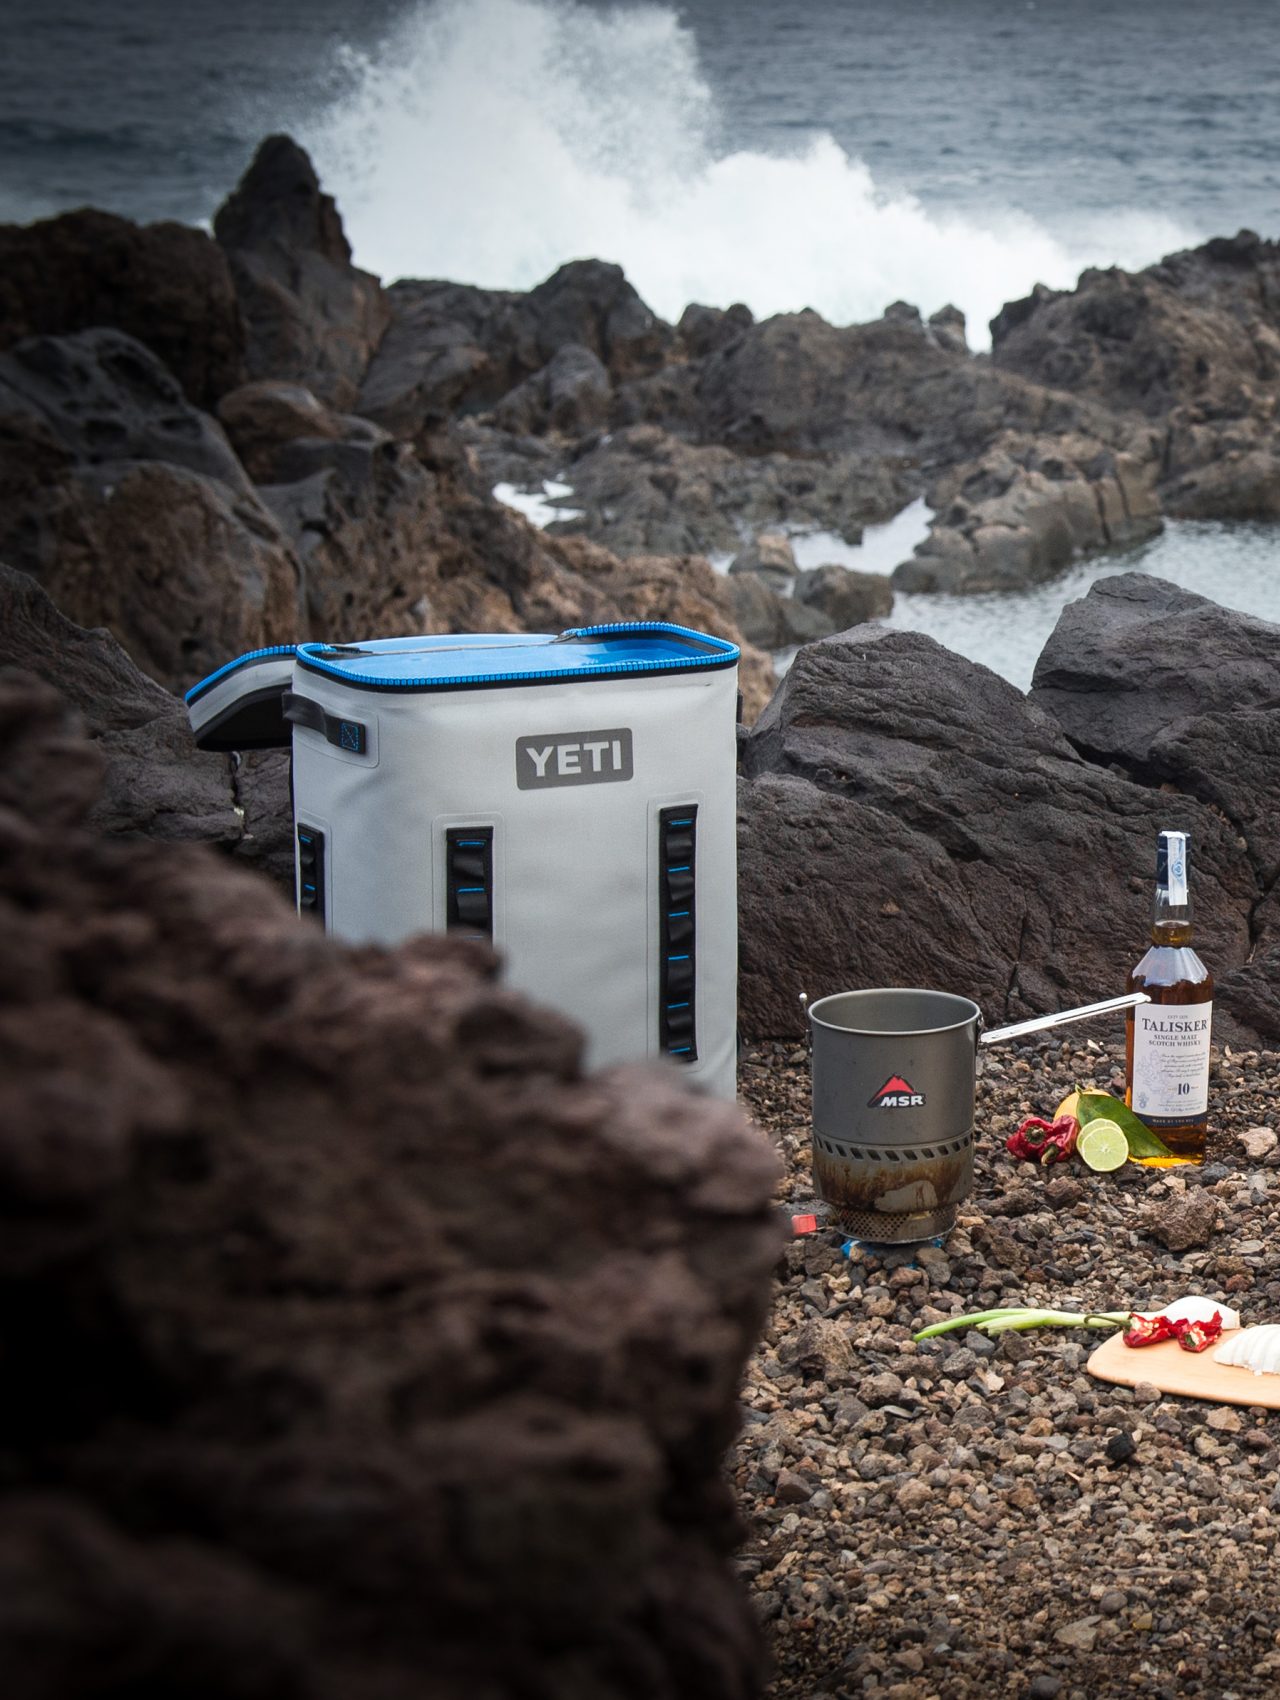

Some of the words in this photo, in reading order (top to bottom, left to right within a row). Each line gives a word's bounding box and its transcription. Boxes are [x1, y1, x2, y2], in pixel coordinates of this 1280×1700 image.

[525, 740, 622, 777] YETI
[1141, 1018, 1208, 1033] TALISKER
[1177, 1082, 1190, 1096] 10
[880, 1095, 924, 1107] MSR
